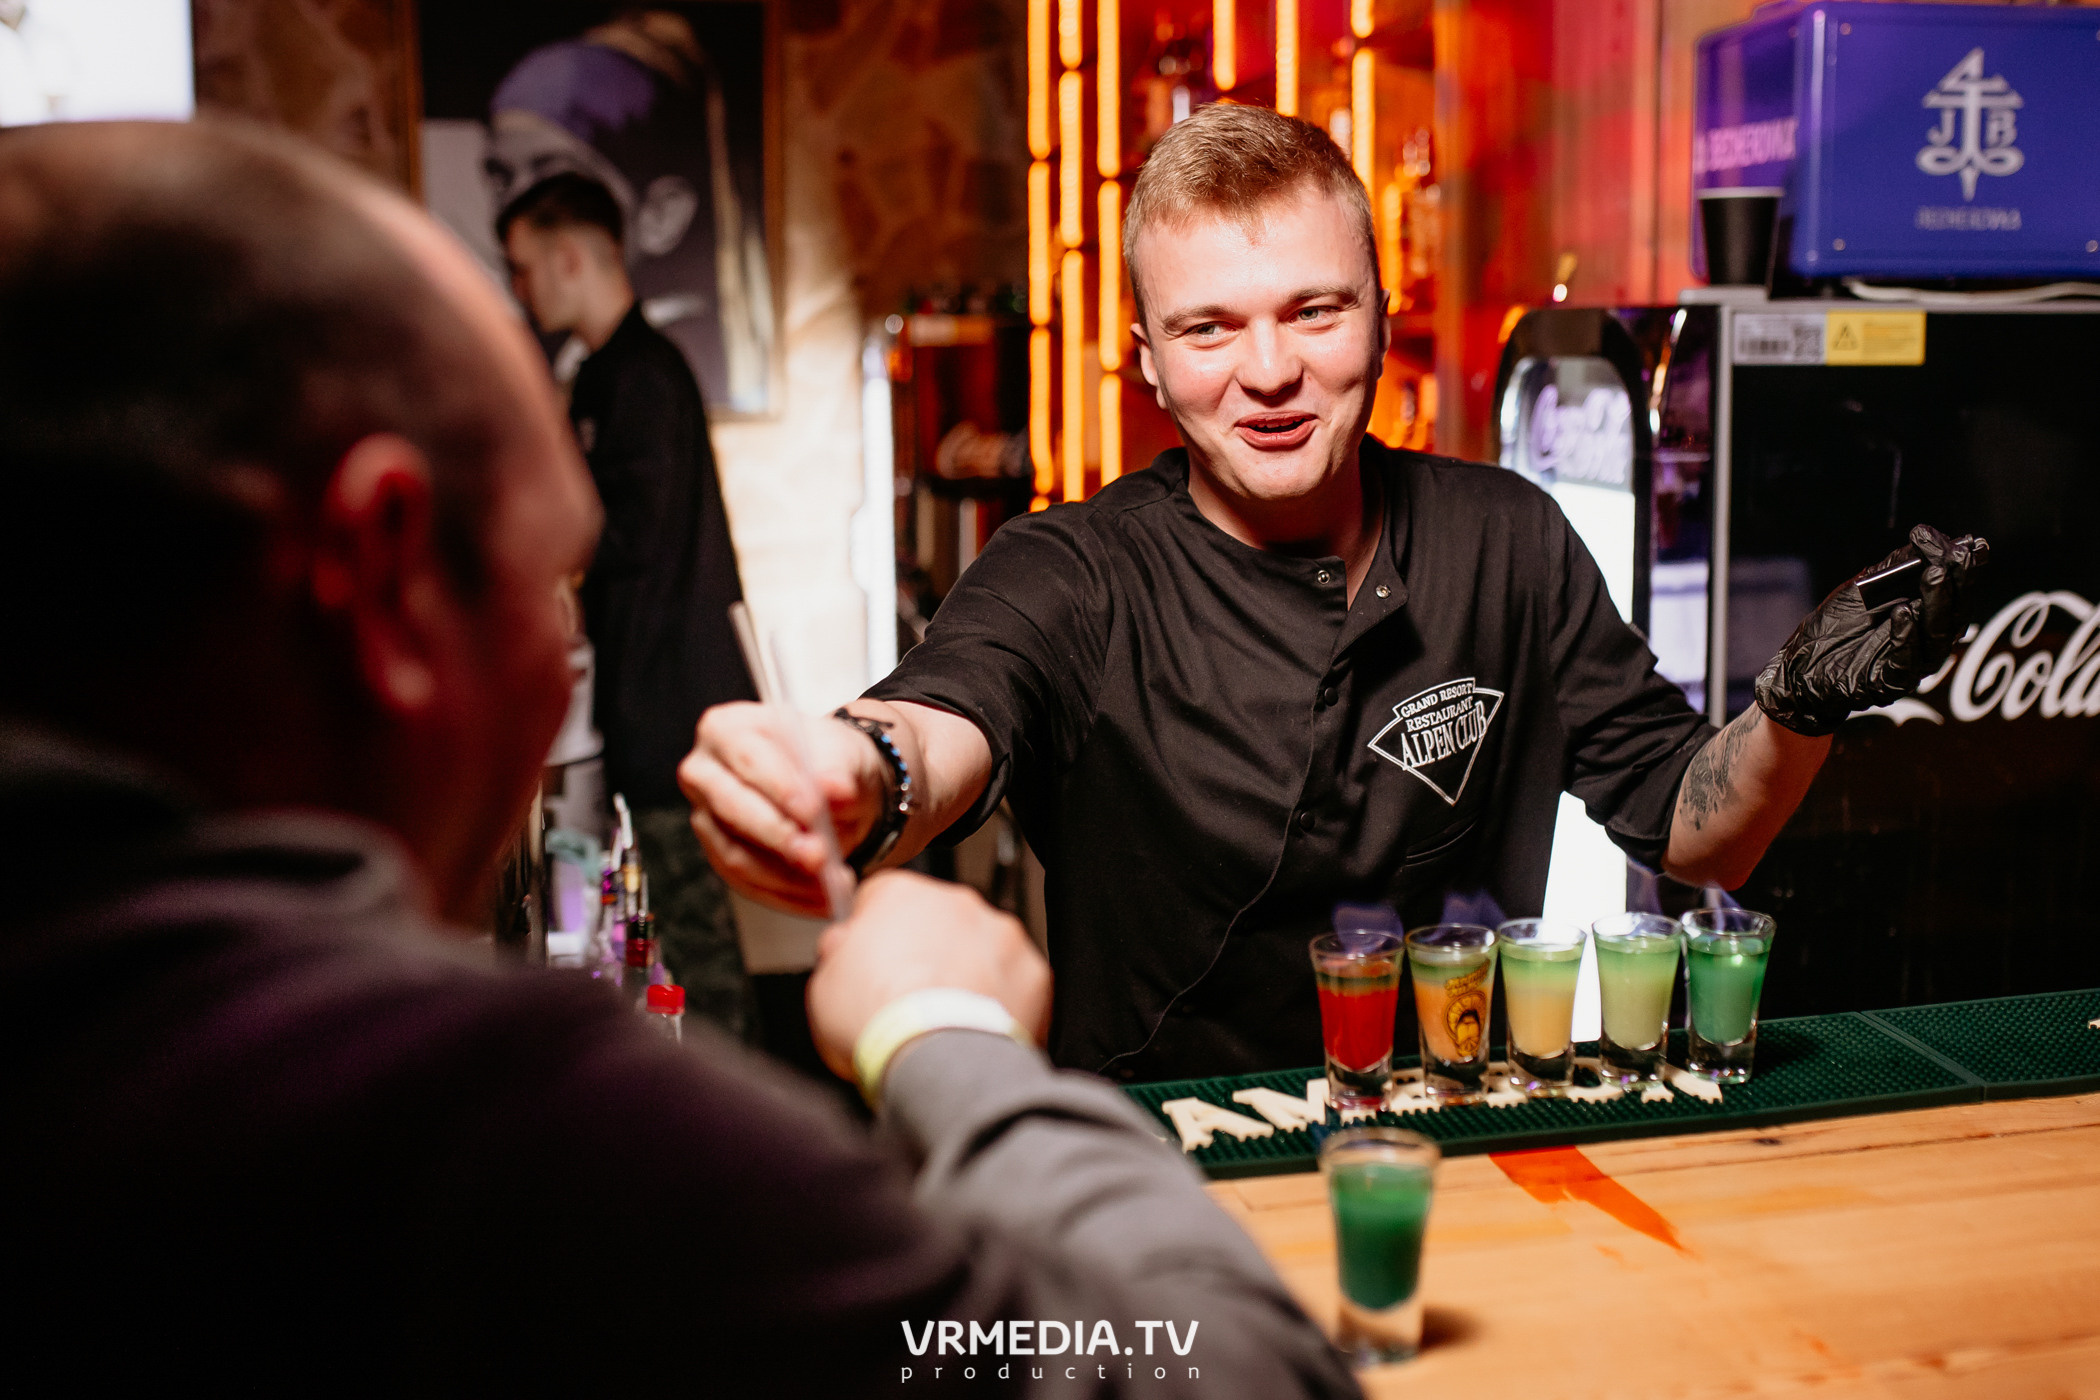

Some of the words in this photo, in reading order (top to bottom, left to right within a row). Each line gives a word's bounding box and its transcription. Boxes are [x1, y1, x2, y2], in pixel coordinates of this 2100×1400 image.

[1400, 694, 1439, 718] GRAND
[1439, 682, 1473, 701] RESORT
[1405, 696, 1473, 732] RESTAURANT
[1401, 721, 1457, 771] ALPEN
[1455, 700, 1487, 750] CLUB
